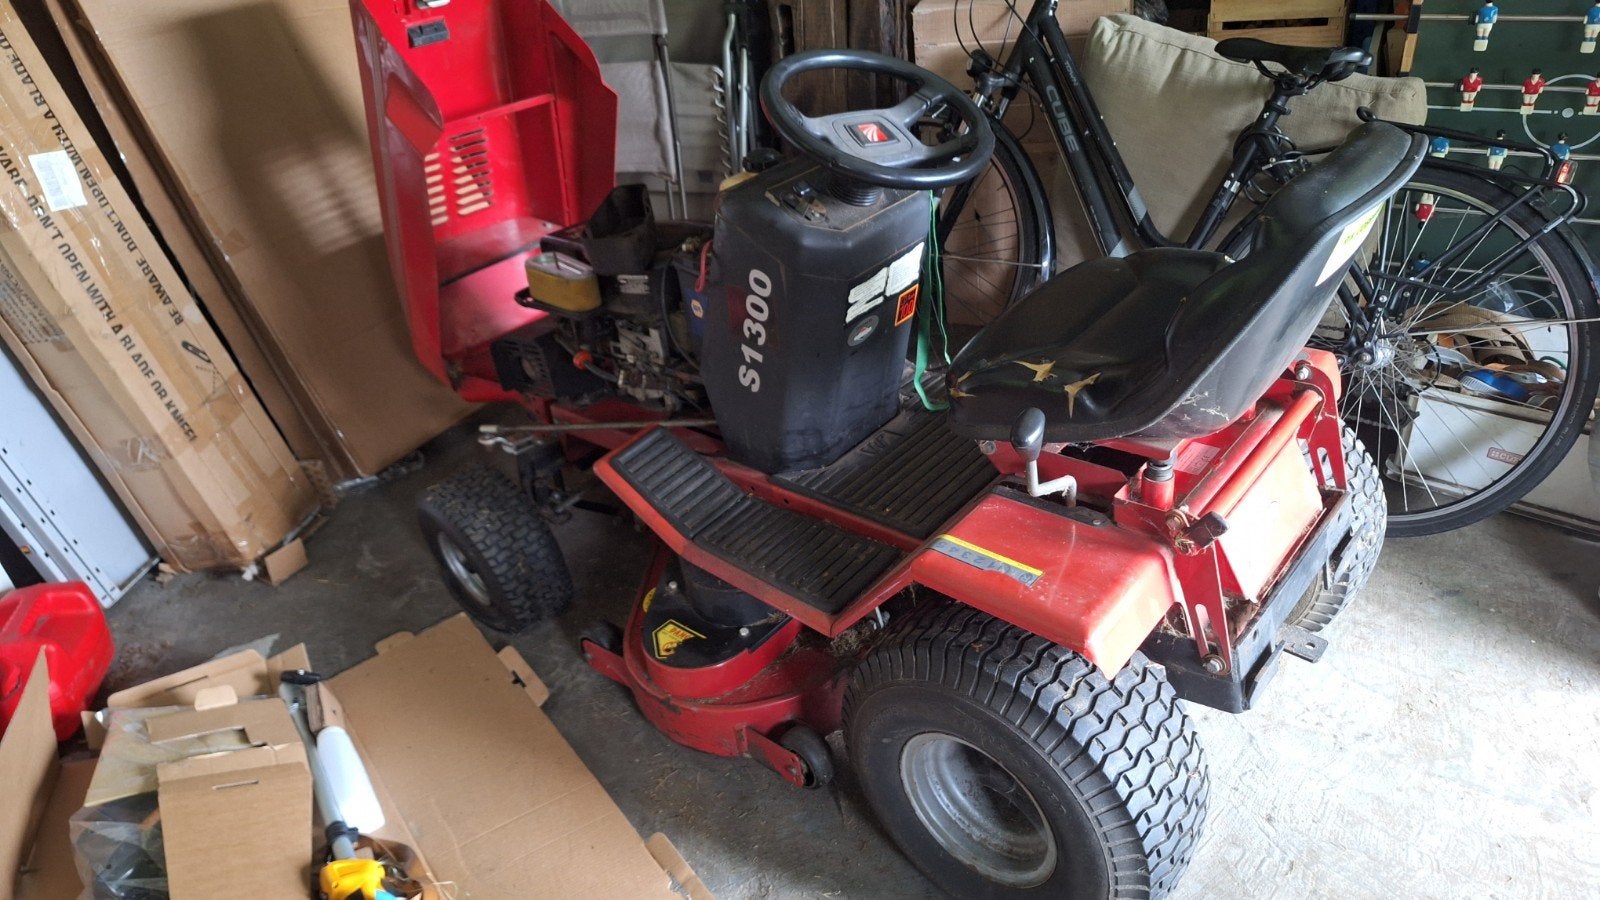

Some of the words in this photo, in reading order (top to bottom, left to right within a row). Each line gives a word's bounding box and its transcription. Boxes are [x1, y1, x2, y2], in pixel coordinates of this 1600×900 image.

[44, 108, 56, 119] A
[1046, 85, 1080, 154] CUBE
[86, 283, 116, 322] WITH
[111, 323, 124, 335] A
[738, 268, 772, 393] S1300
